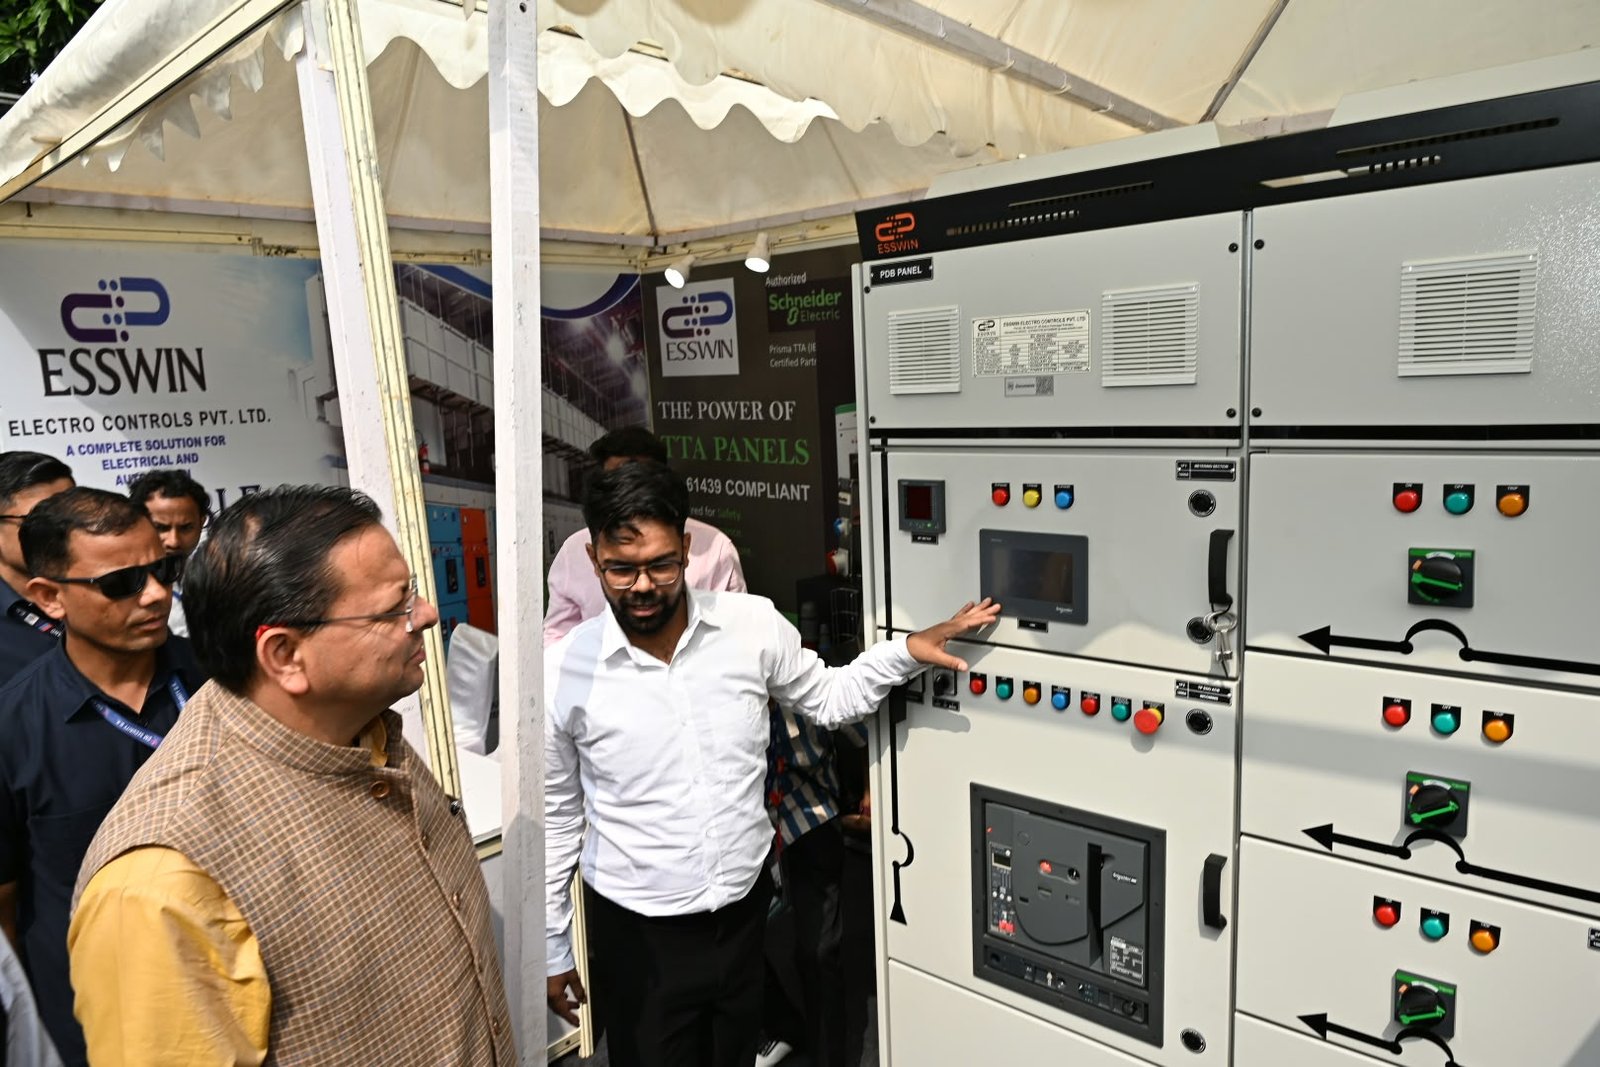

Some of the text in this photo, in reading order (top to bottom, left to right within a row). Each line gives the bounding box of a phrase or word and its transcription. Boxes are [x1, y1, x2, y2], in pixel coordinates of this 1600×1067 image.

[877, 239, 919, 254] ESSWIN
[765, 272, 807, 287] Authorized
[880, 265, 922, 279] PDB PANEL
[769, 288, 842, 311] Schneider
[800, 309, 841, 322] Electric
[666, 338, 734, 361] ESSWIN
[769, 344, 792, 354] Prisma
[793, 343, 807, 353] TTA
[38, 348, 207, 396] ESSWIN
[769, 357, 799, 368] Certified
[658, 400, 797, 421] THE POWER OF
[9, 408, 271, 437] ELECTRO CONTROLS PVT. LTD.
[66, 435, 227, 457] A COMPLETE SOLUTION FOR
[660, 435, 811, 465] TTA PANELS
[102, 453, 199, 471] ELECTRICAL AND
[686, 477, 811, 502] 61439 COMPLIANT
[704, 506, 716, 516] for
